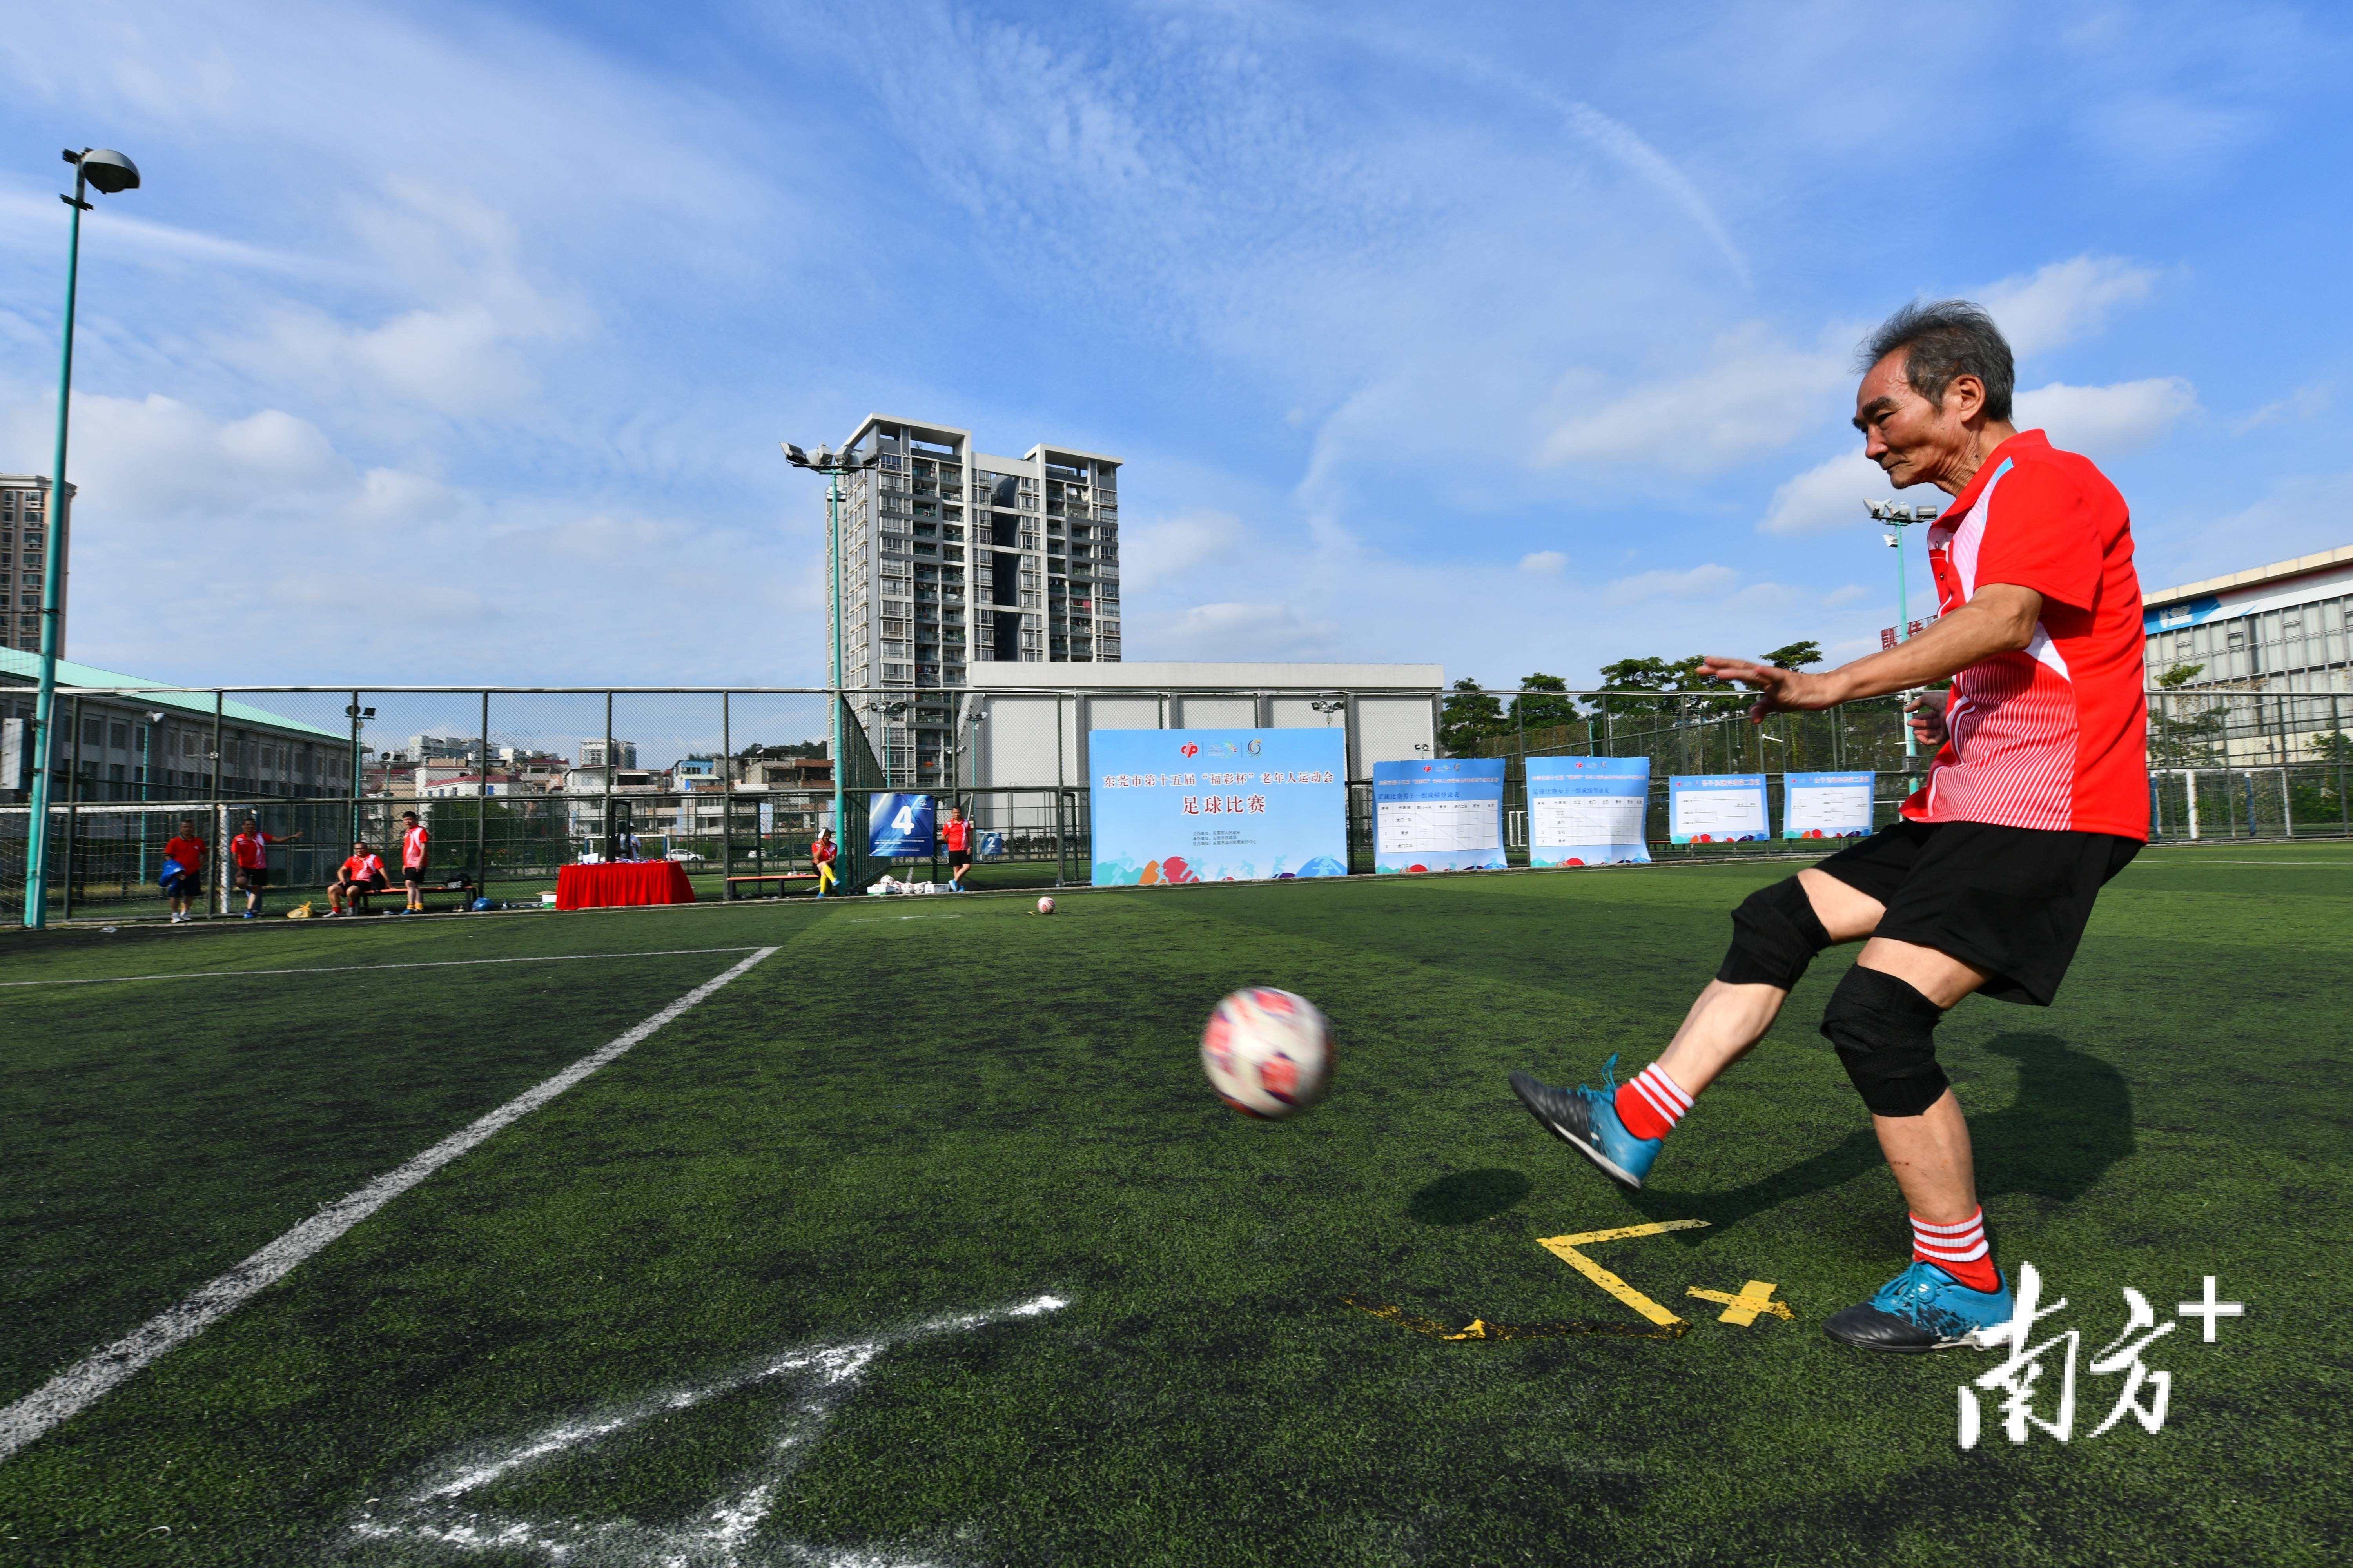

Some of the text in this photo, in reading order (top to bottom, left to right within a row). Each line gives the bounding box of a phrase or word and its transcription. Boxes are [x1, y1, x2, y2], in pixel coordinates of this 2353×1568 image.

[1183, 795, 1265, 815] 足球比赛
[891, 806, 915, 835] 4
[987, 837, 995, 848] 2
